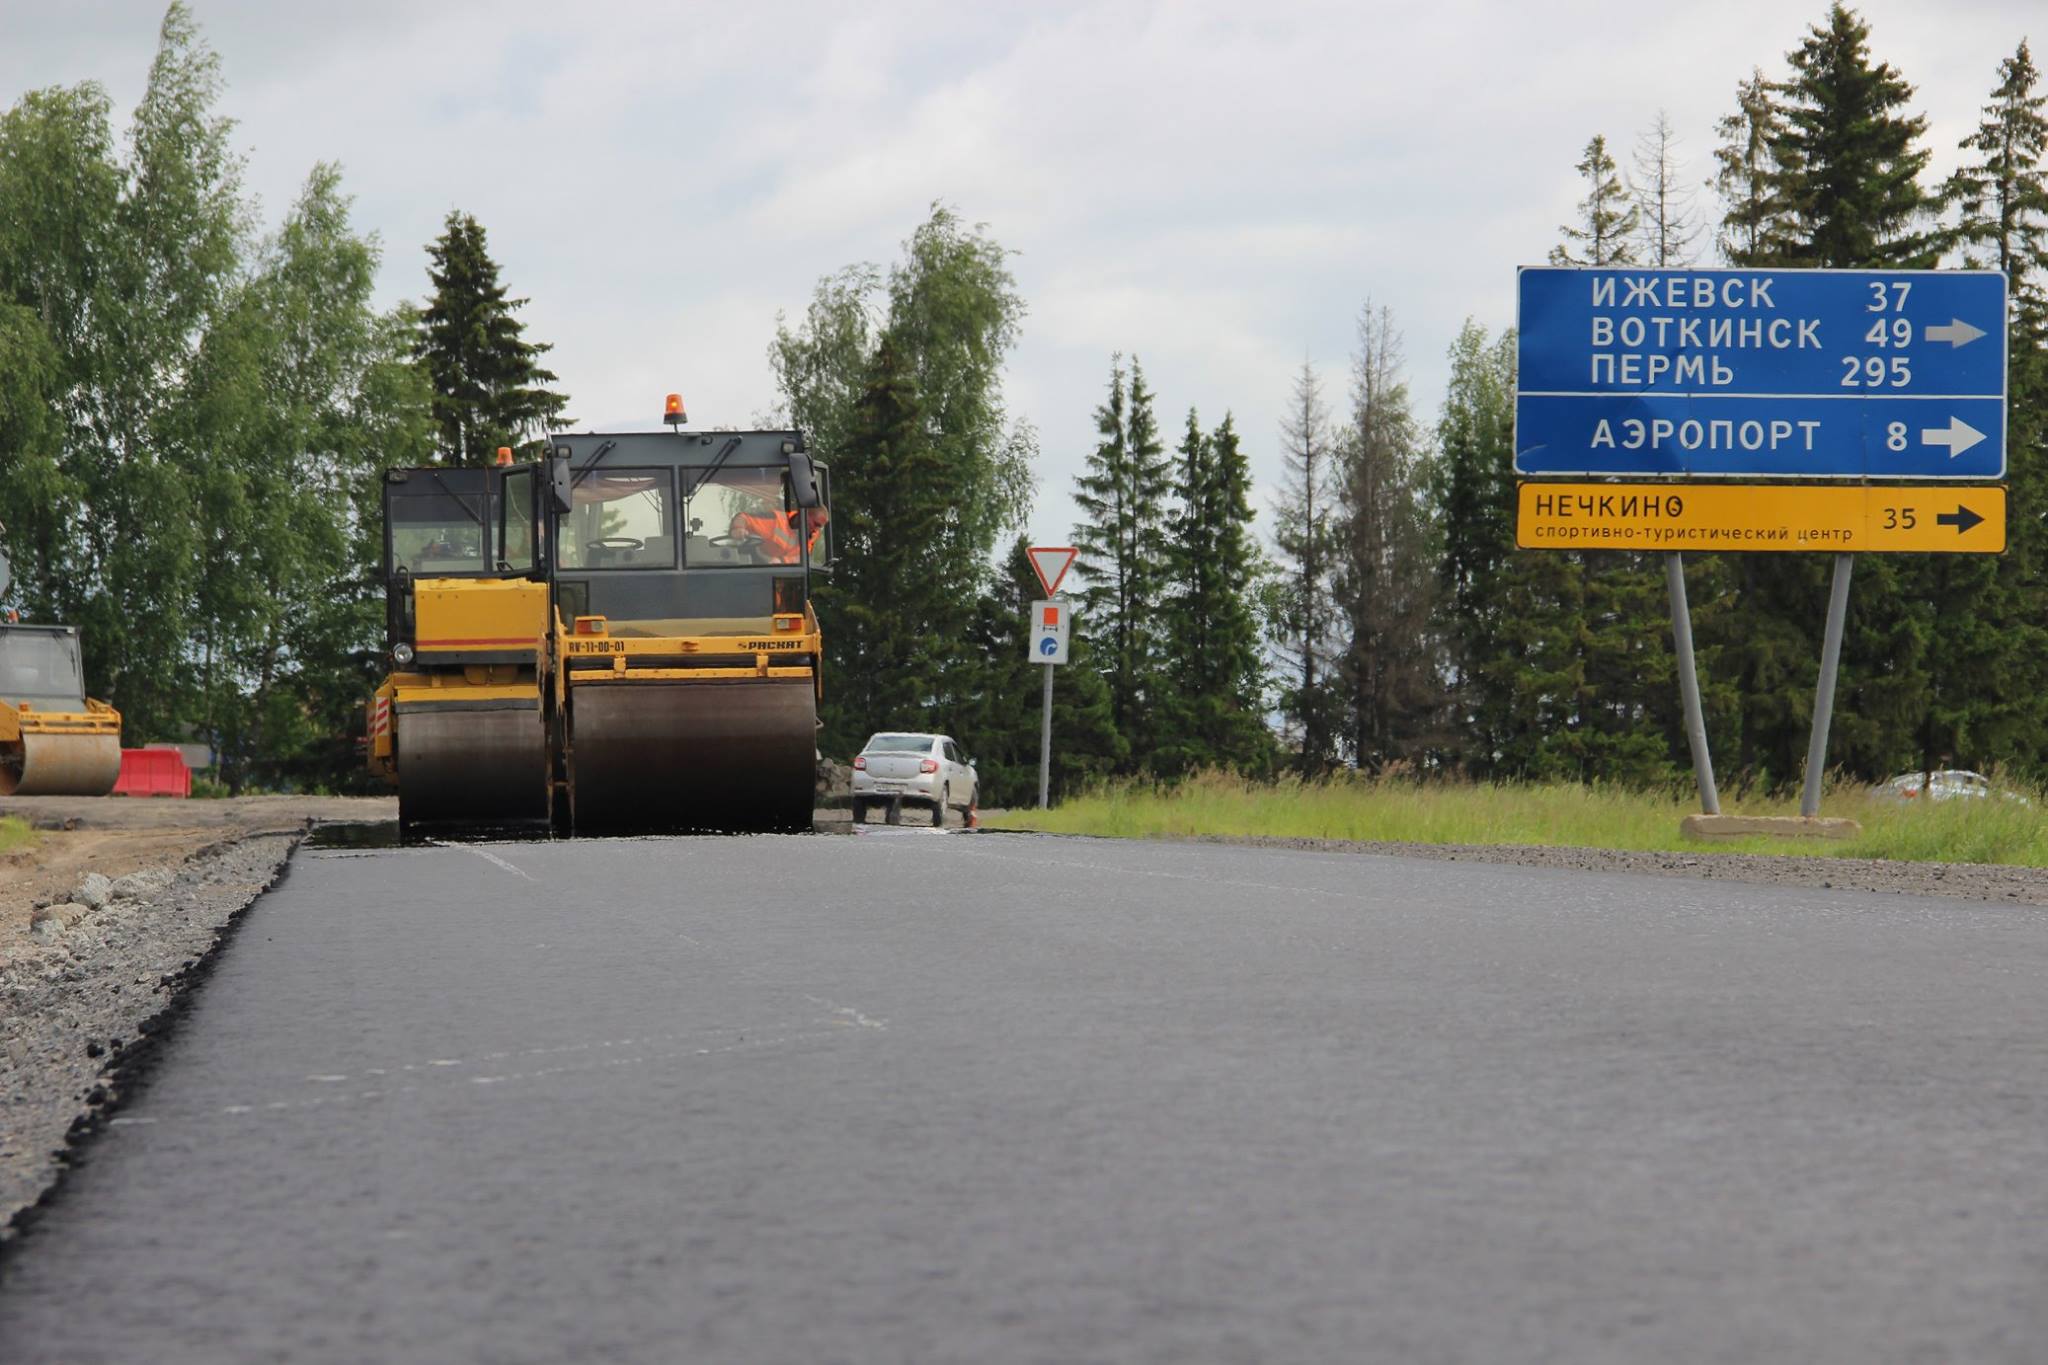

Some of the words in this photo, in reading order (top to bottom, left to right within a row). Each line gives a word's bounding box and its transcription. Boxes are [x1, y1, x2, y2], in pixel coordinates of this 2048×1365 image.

[1592, 277, 1775, 308] ИЖЕВСК
[1868, 280, 1912, 312] 37
[1592, 316, 1823, 349] ВОТКИНСК
[1865, 318, 1912, 349] 49
[1592, 353, 1735, 385] ПЕРМЬ
[1841, 356, 1912, 388] 295
[1591, 419, 1822, 450] АЭРОПОРТ
[1886, 421, 1908, 451] 8
[1535, 494, 1684, 518] НЕЧКИНО
[1883, 508, 1917, 531] 35
[1535, 526, 1788, 543] спортивно-туристический
[1797, 528, 1854, 544] центр
